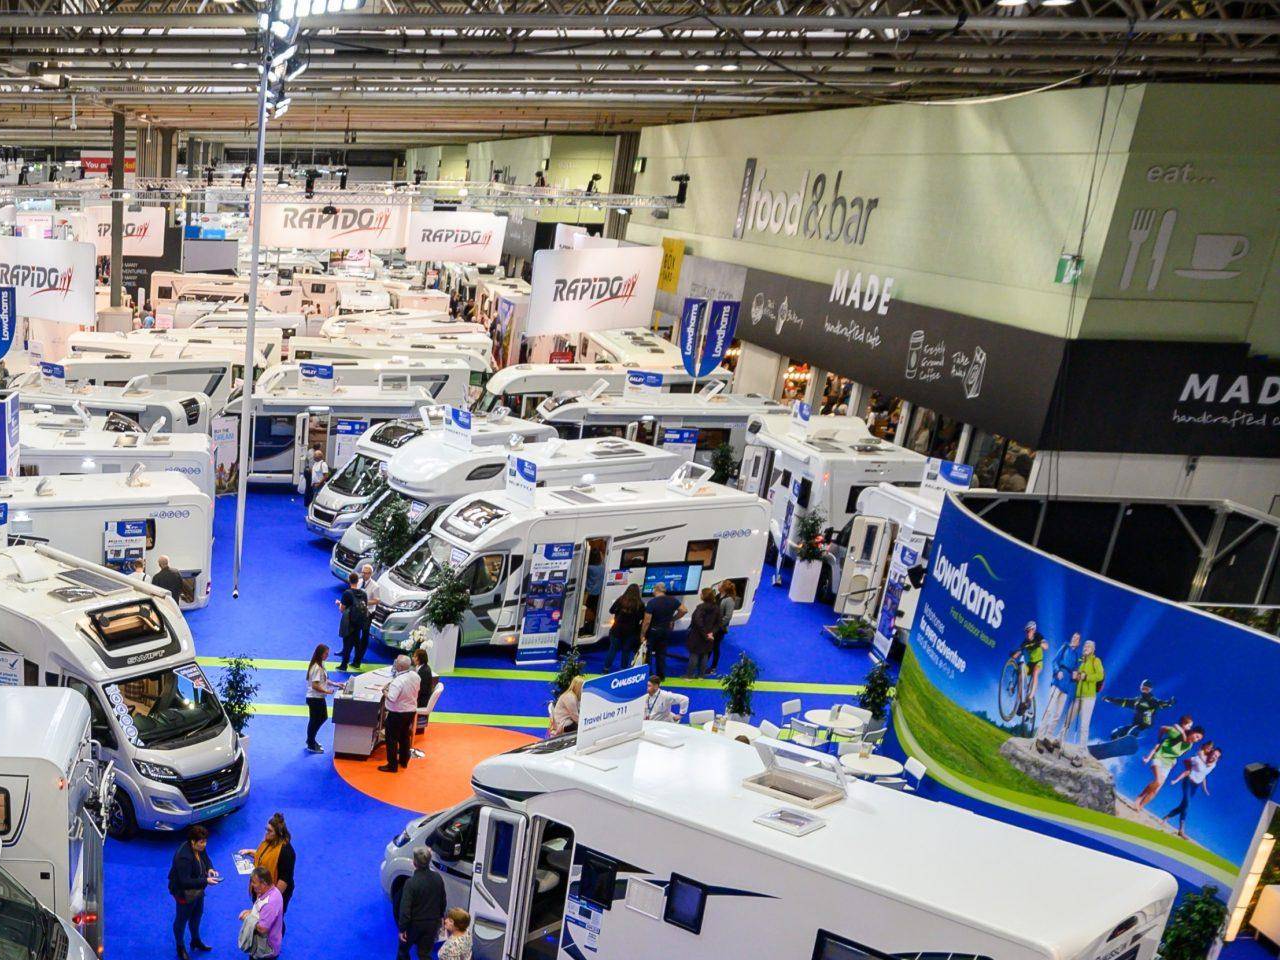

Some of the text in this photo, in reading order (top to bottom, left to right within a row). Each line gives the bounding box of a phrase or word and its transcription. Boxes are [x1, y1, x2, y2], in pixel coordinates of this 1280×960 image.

[0, 291, 9, 341] Lowdhams
[829, 268, 894, 316] MADE
[684, 304, 699, 356] Lowdhams
[712, 305, 731, 358] Lowdhams
[933, 544, 1005, 629] Lowdhams
[584, 713, 601, 726] Travel
[602, 709, 615, 719] Line
[616, 705, 628, 715] 711
